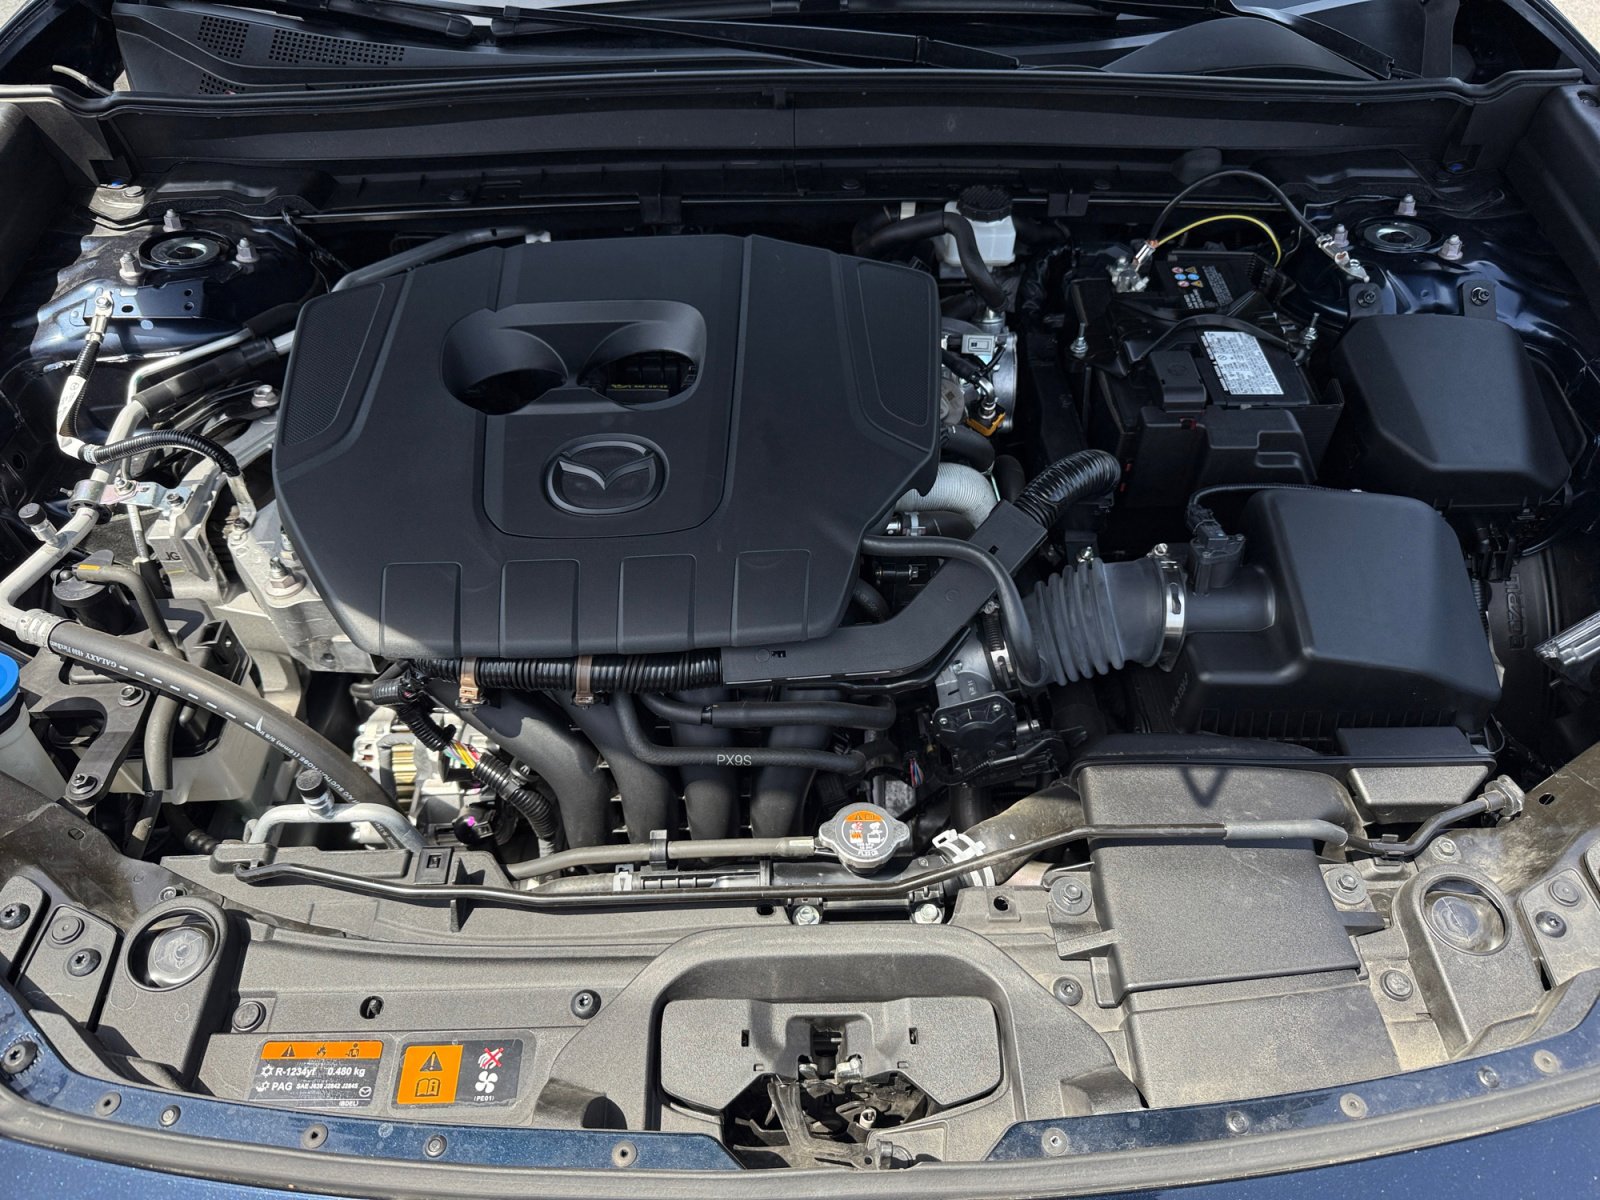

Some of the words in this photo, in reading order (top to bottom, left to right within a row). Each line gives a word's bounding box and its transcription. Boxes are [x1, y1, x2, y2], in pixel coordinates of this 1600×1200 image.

[85, 653, 117, 668] GALAXY
[299, 756, 319, 772] HOSE
[716, 754, 752, 766] PX9S
[275, 1067, 318, 1077] R-1234yf
[327, 1067, 352, 1076] 0.480
[353, 1067, 366, 1077] kg
[271, 1082, 293, 1091] PAG
